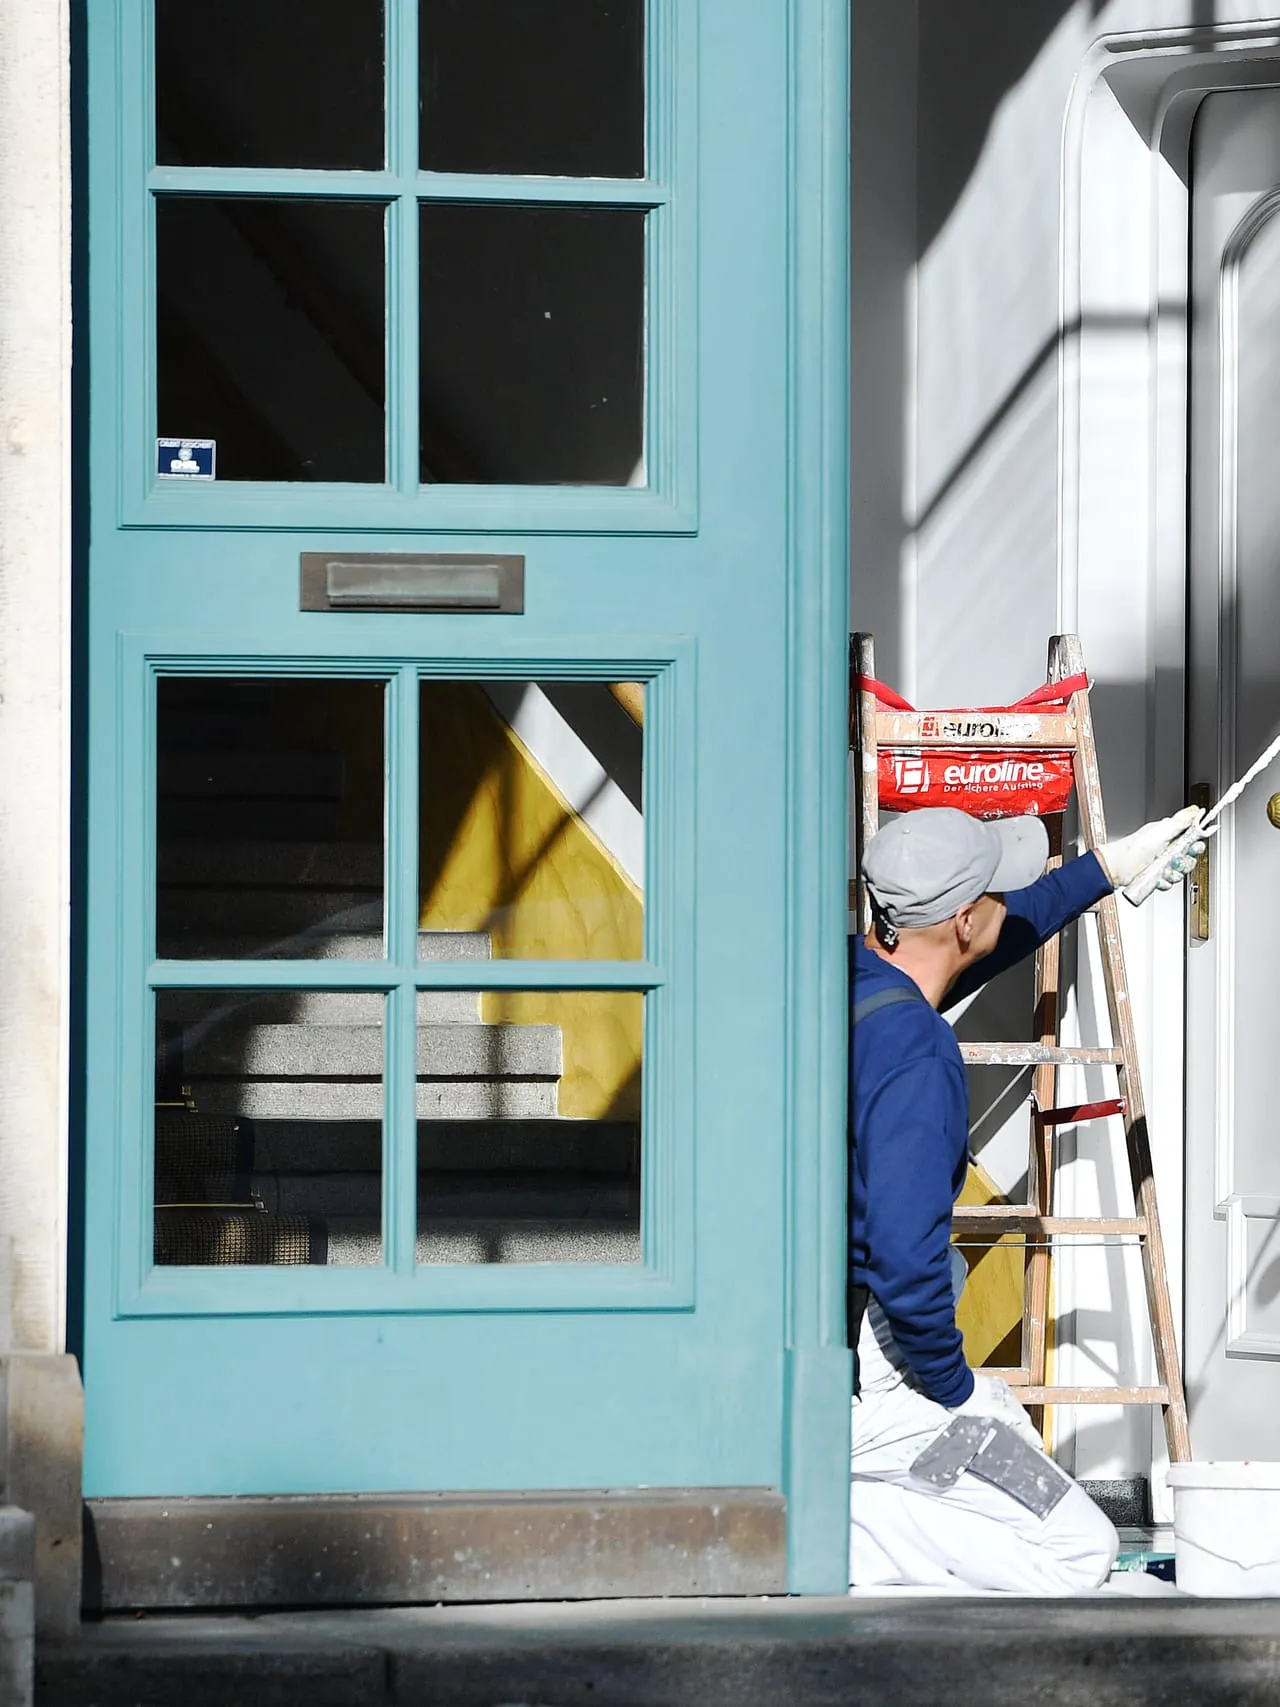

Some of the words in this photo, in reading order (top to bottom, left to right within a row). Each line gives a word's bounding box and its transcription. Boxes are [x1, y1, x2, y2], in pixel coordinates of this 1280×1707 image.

[943, 759, 1044, 785] euroline
[943, 785, 961, 793] Der
[963, 783, 999, 793] sichere
